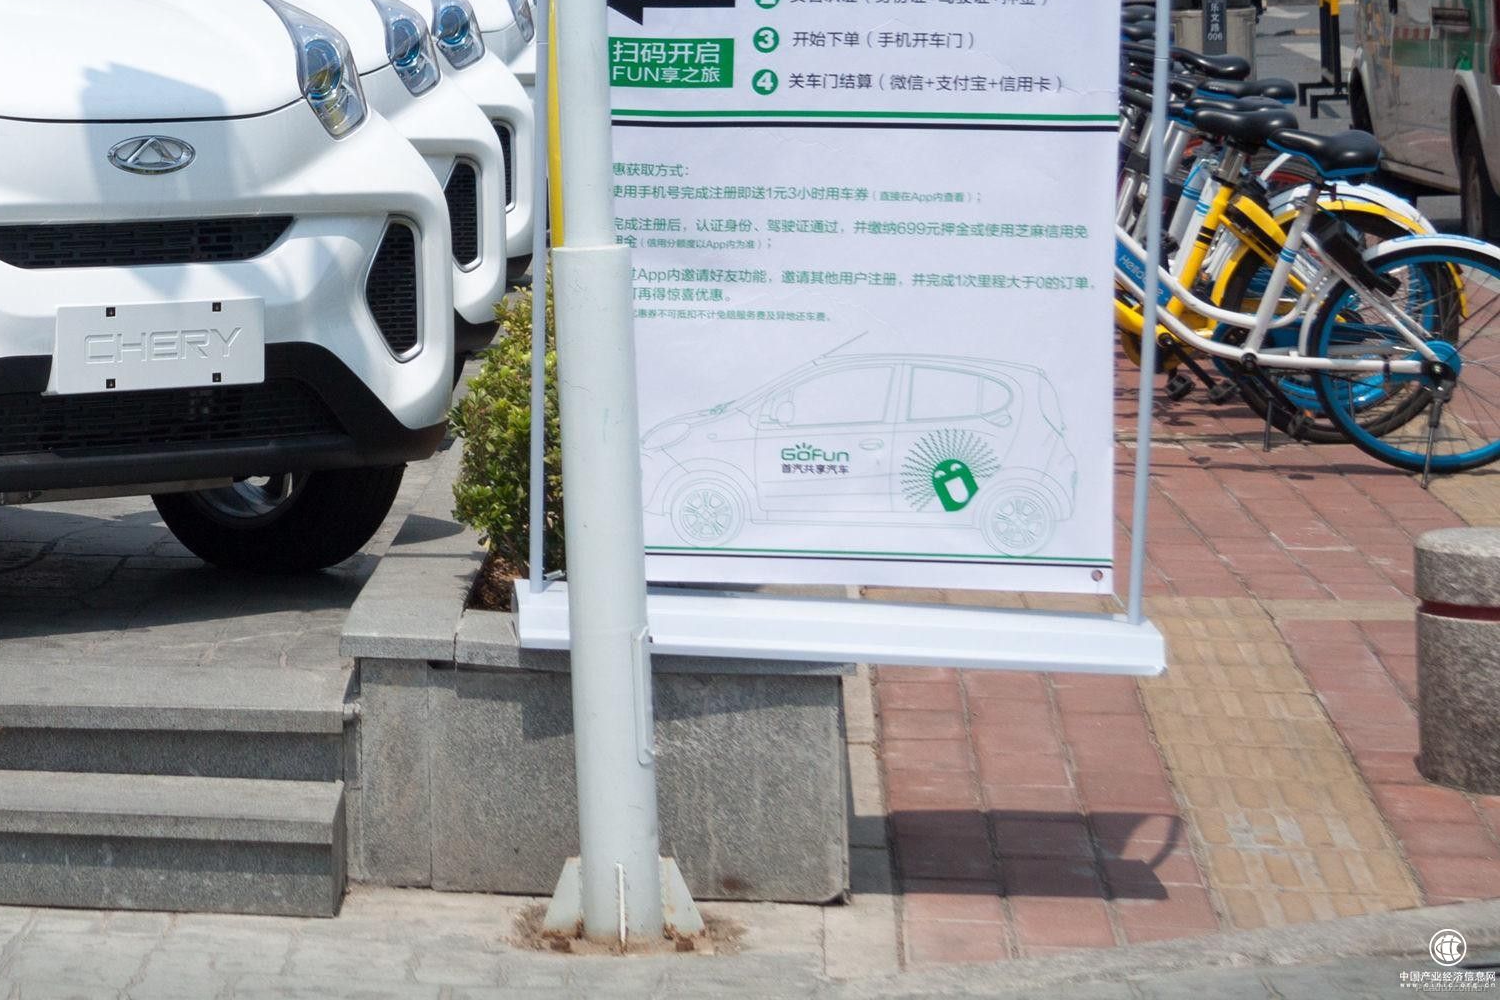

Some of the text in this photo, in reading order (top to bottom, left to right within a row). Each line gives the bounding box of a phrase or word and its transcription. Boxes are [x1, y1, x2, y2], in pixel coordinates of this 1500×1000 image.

[613, 41, 721, 65] 扫码开启
[612, 65, 721, 84] FUN享之旅
[84, 326, 244, 365] CHERY
[781, 442, 850, 462] GoFun
[781, 463, 850, 475] 首汽共享汽车
